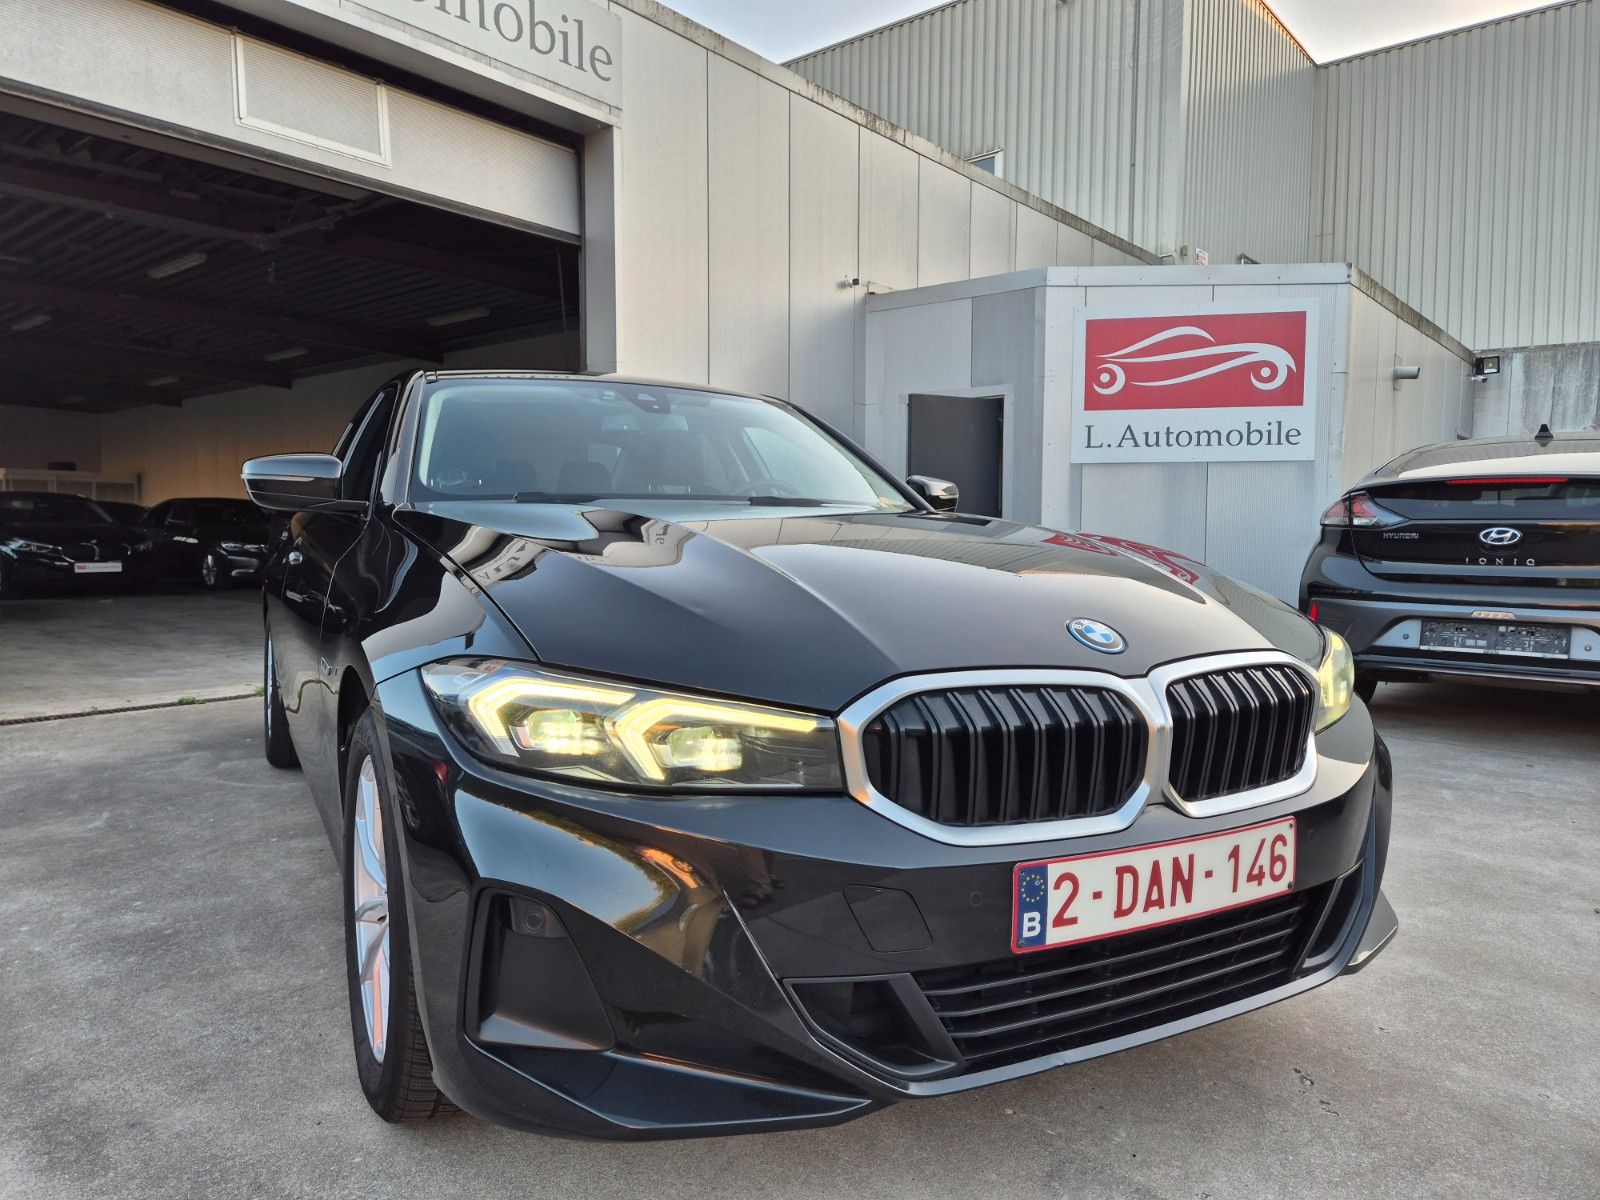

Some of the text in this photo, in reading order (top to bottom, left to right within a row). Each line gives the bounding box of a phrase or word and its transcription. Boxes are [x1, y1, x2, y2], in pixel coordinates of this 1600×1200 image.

[1084, 421, 1302, 449] L.Automobile
[1465, 557, 1535, 567] IONIQ
[1022, 911, 1041, 938] B
